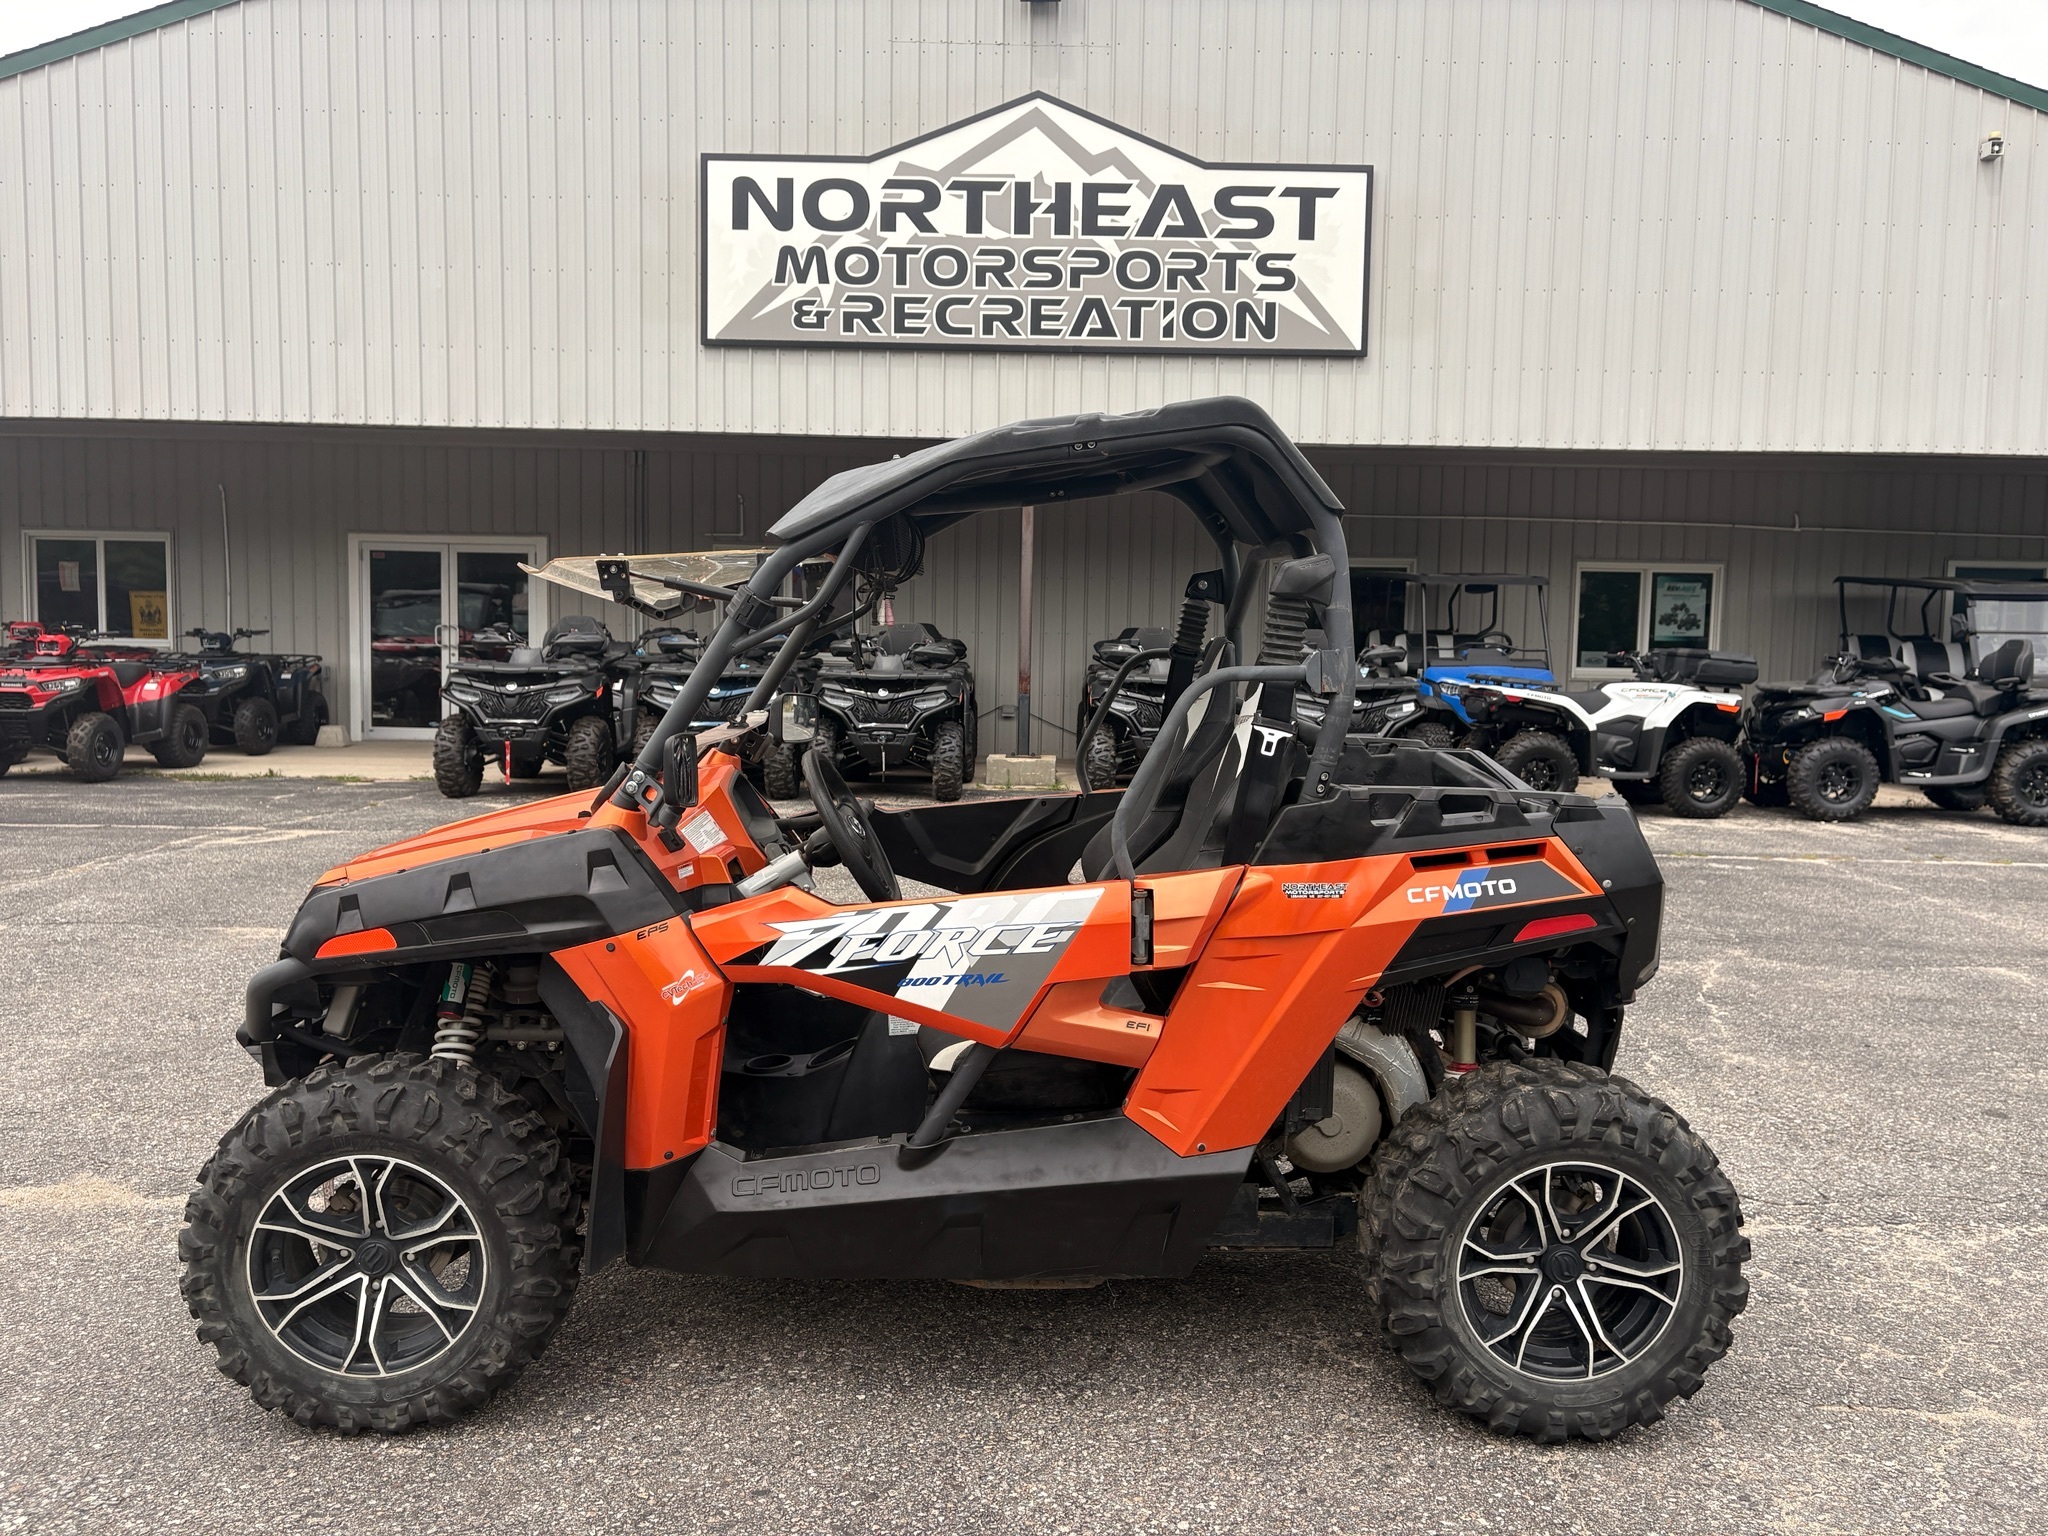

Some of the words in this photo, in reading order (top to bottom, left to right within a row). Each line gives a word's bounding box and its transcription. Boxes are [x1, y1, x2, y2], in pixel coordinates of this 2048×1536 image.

[731, 175, 1341, 242] NORTHEAST
[773, 245, 1297, 293] MOTORSPORTS
[1407, 878, 1517, 903] CFMOTO
[637, 922, 669, 940] EPS
[1126, 1020, 1151, 1032] EFI
[732, 1163, 881, 1197] CFMOTO
